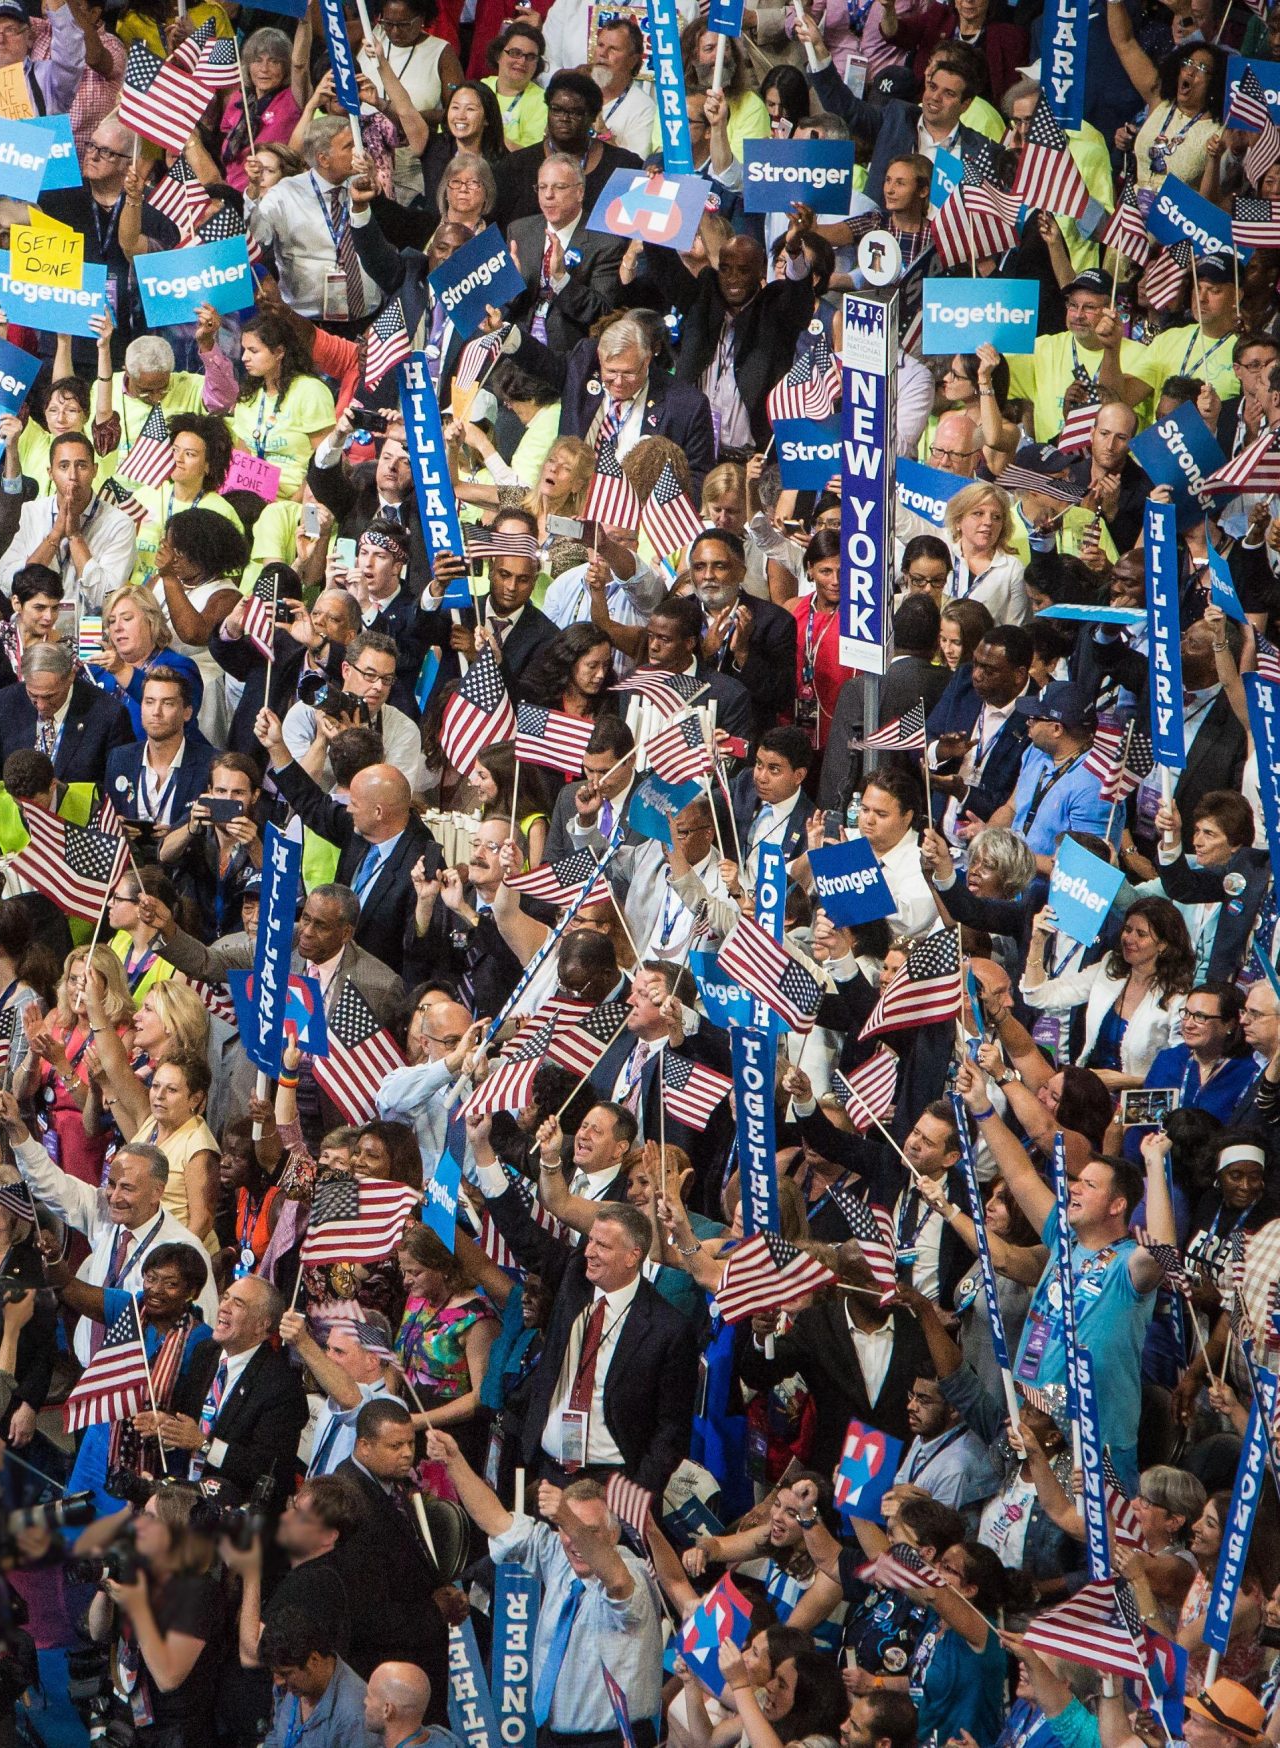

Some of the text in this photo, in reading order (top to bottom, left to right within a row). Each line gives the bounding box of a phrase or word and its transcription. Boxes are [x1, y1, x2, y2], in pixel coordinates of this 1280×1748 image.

[3, 68, 17, 86] IT
[748, 161, 850, 189] Stronger
[17, 231, 80, 256] GET IT
[26, 256, 72, 278] DONE
[142, 261, 248, 298] Together
[441, 247, 508, 312] Stronger
[926, 302, 1034, 329] Together
[844, 371, 883, 480] NEW
[232, 453, 255, 473] GET
[257, 462, 271, 476] IT
[404, 362, 452, 555] HILLAR
[1157, 419, 1218, 511] Stronger
[236, 473, 262, 491] DONE
[847, 496, 878, 642] YORK
[1149, 510, 1174, 736] HILLARY
[817, 867, 878, 898] Stronger
[258, 845, 288, 1045] HILLARY
[741, 1036, 770, 1235] TOGETHE
[427, 1177, 457, 1216] ogether
[1077, 1356, 1109, 1580] STRONGER
